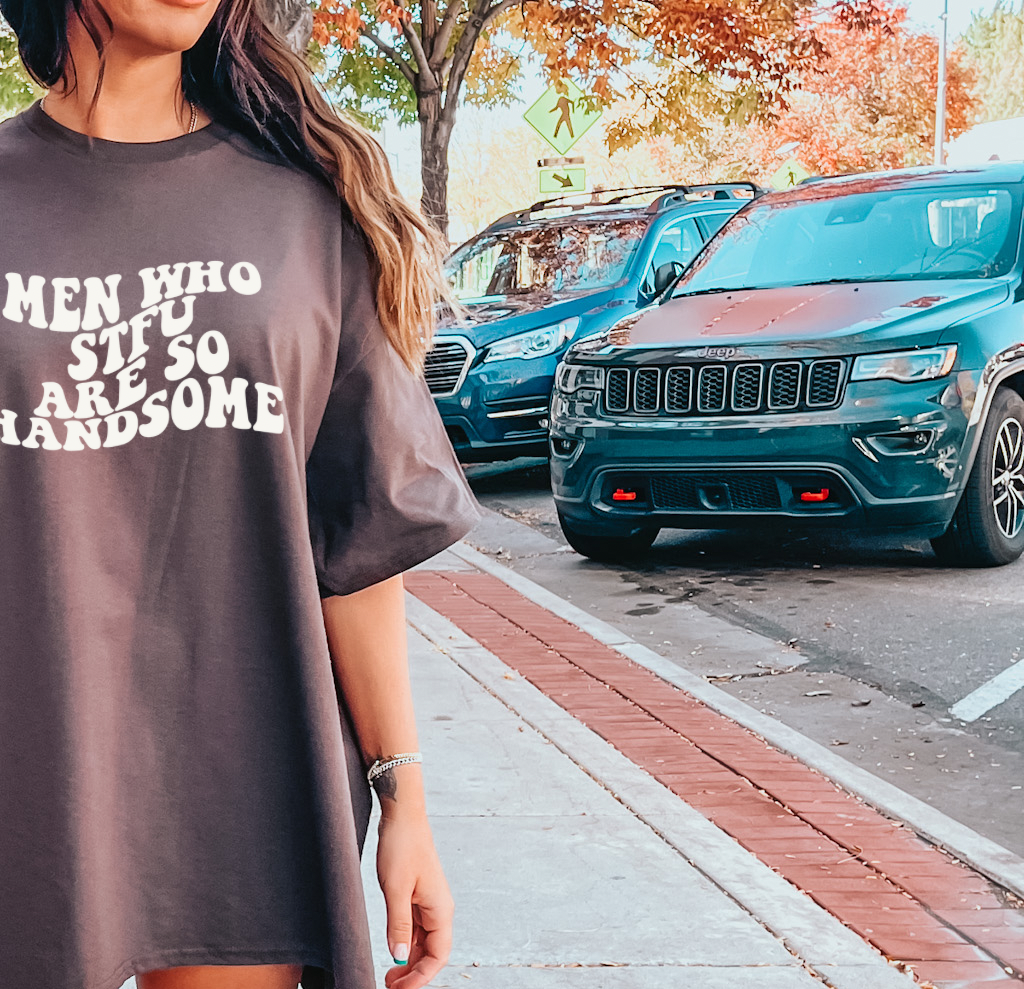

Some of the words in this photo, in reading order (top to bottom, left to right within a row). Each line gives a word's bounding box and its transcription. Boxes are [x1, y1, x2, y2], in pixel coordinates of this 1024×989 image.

[2, 272, 122, 332] MEN
[138, 260, 262, 309] WHO
[33, 356, 147, 419] ARE
[164, 330, 230, 381] SO
[67, 295, 197, 381] STFU
[697, 346, 736, 359] Jeep
